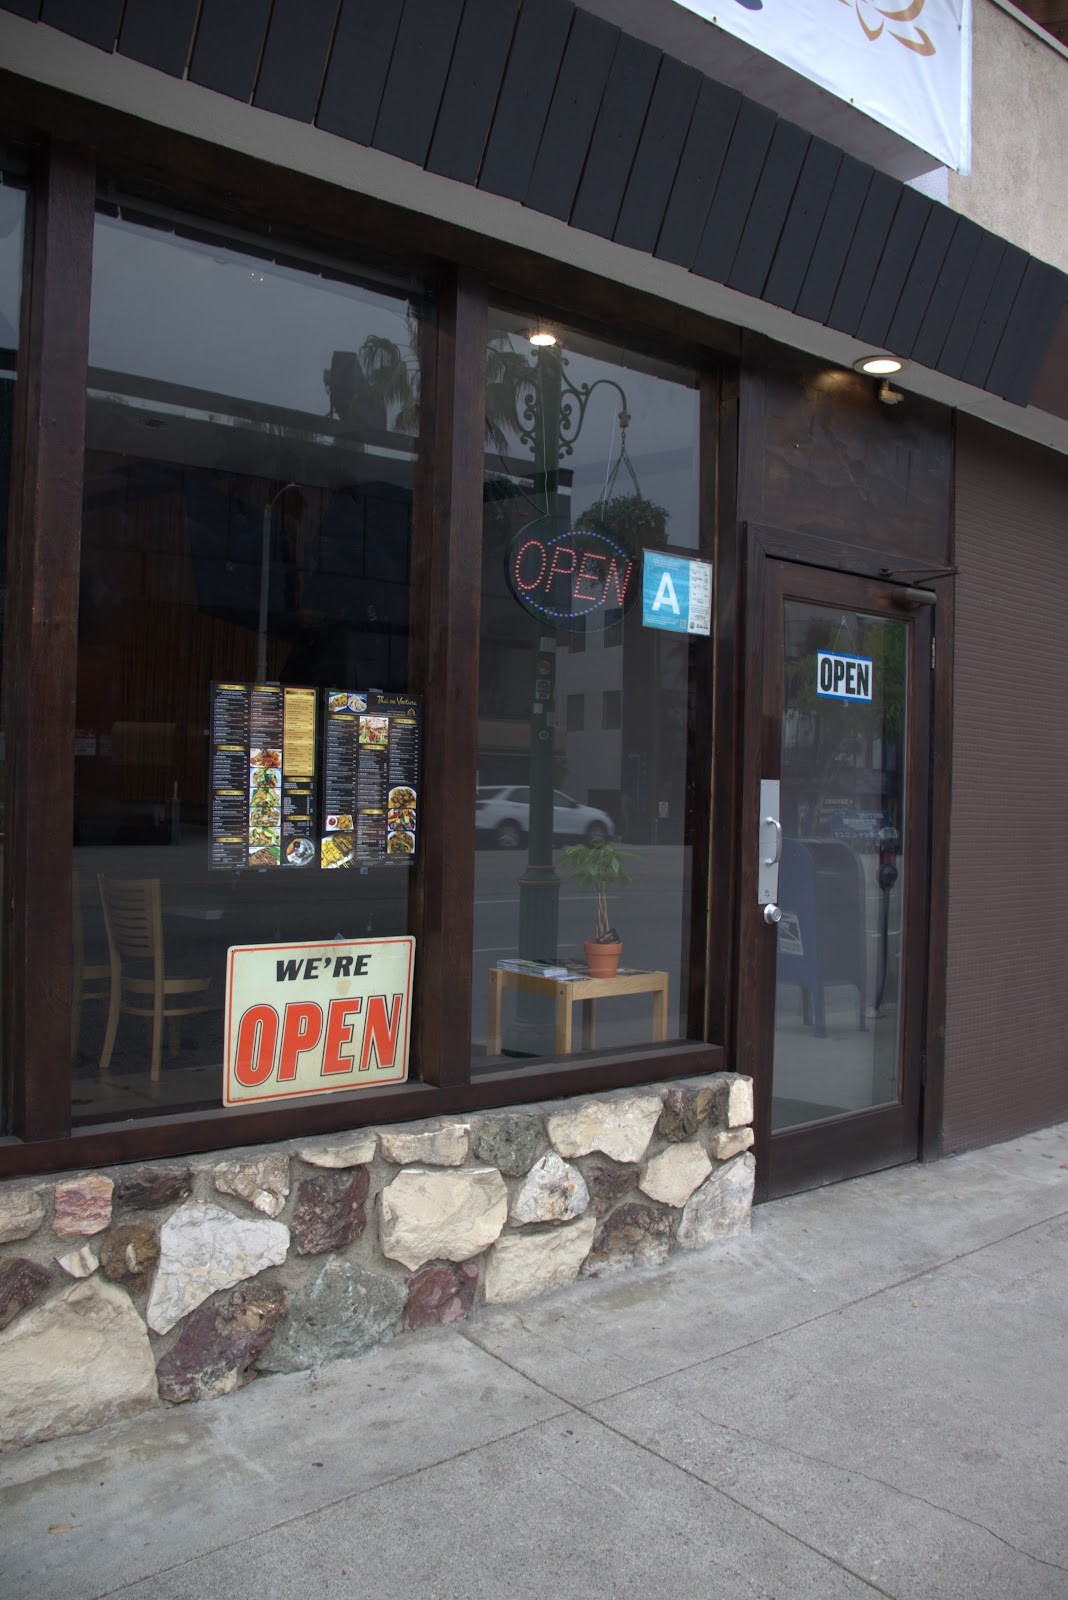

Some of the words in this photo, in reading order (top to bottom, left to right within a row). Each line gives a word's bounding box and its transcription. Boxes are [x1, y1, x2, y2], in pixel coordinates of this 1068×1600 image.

[515, 540, 633, 606] OPEN
[651, 572, 681, 615] A
[820, 657, 870, 697] OPEN
[276, 954, 372, 982] WE'RE
[234, 993, 404, 1087] OPEN
